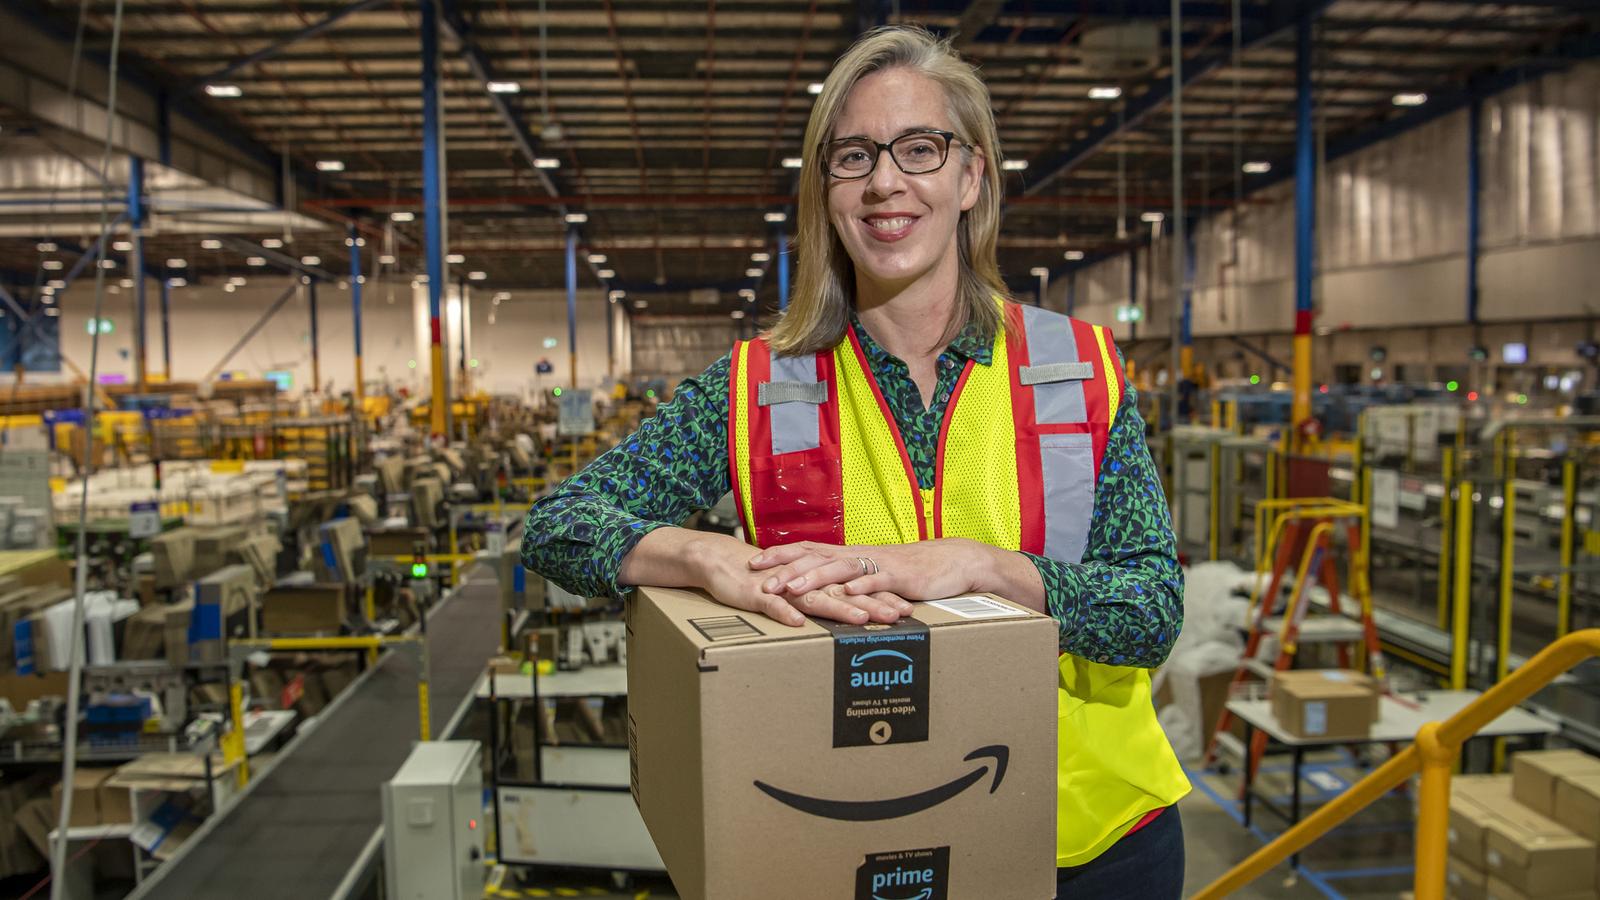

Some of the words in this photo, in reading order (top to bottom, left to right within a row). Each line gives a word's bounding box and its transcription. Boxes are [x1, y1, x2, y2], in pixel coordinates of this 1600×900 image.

[867, 635, 906, 643] membership
[850, 664, 913, 690] prime
[846, 706, 891, 718] streaming
[892, 705, 916, 716] video
[872, 866, 934, 893] prime
